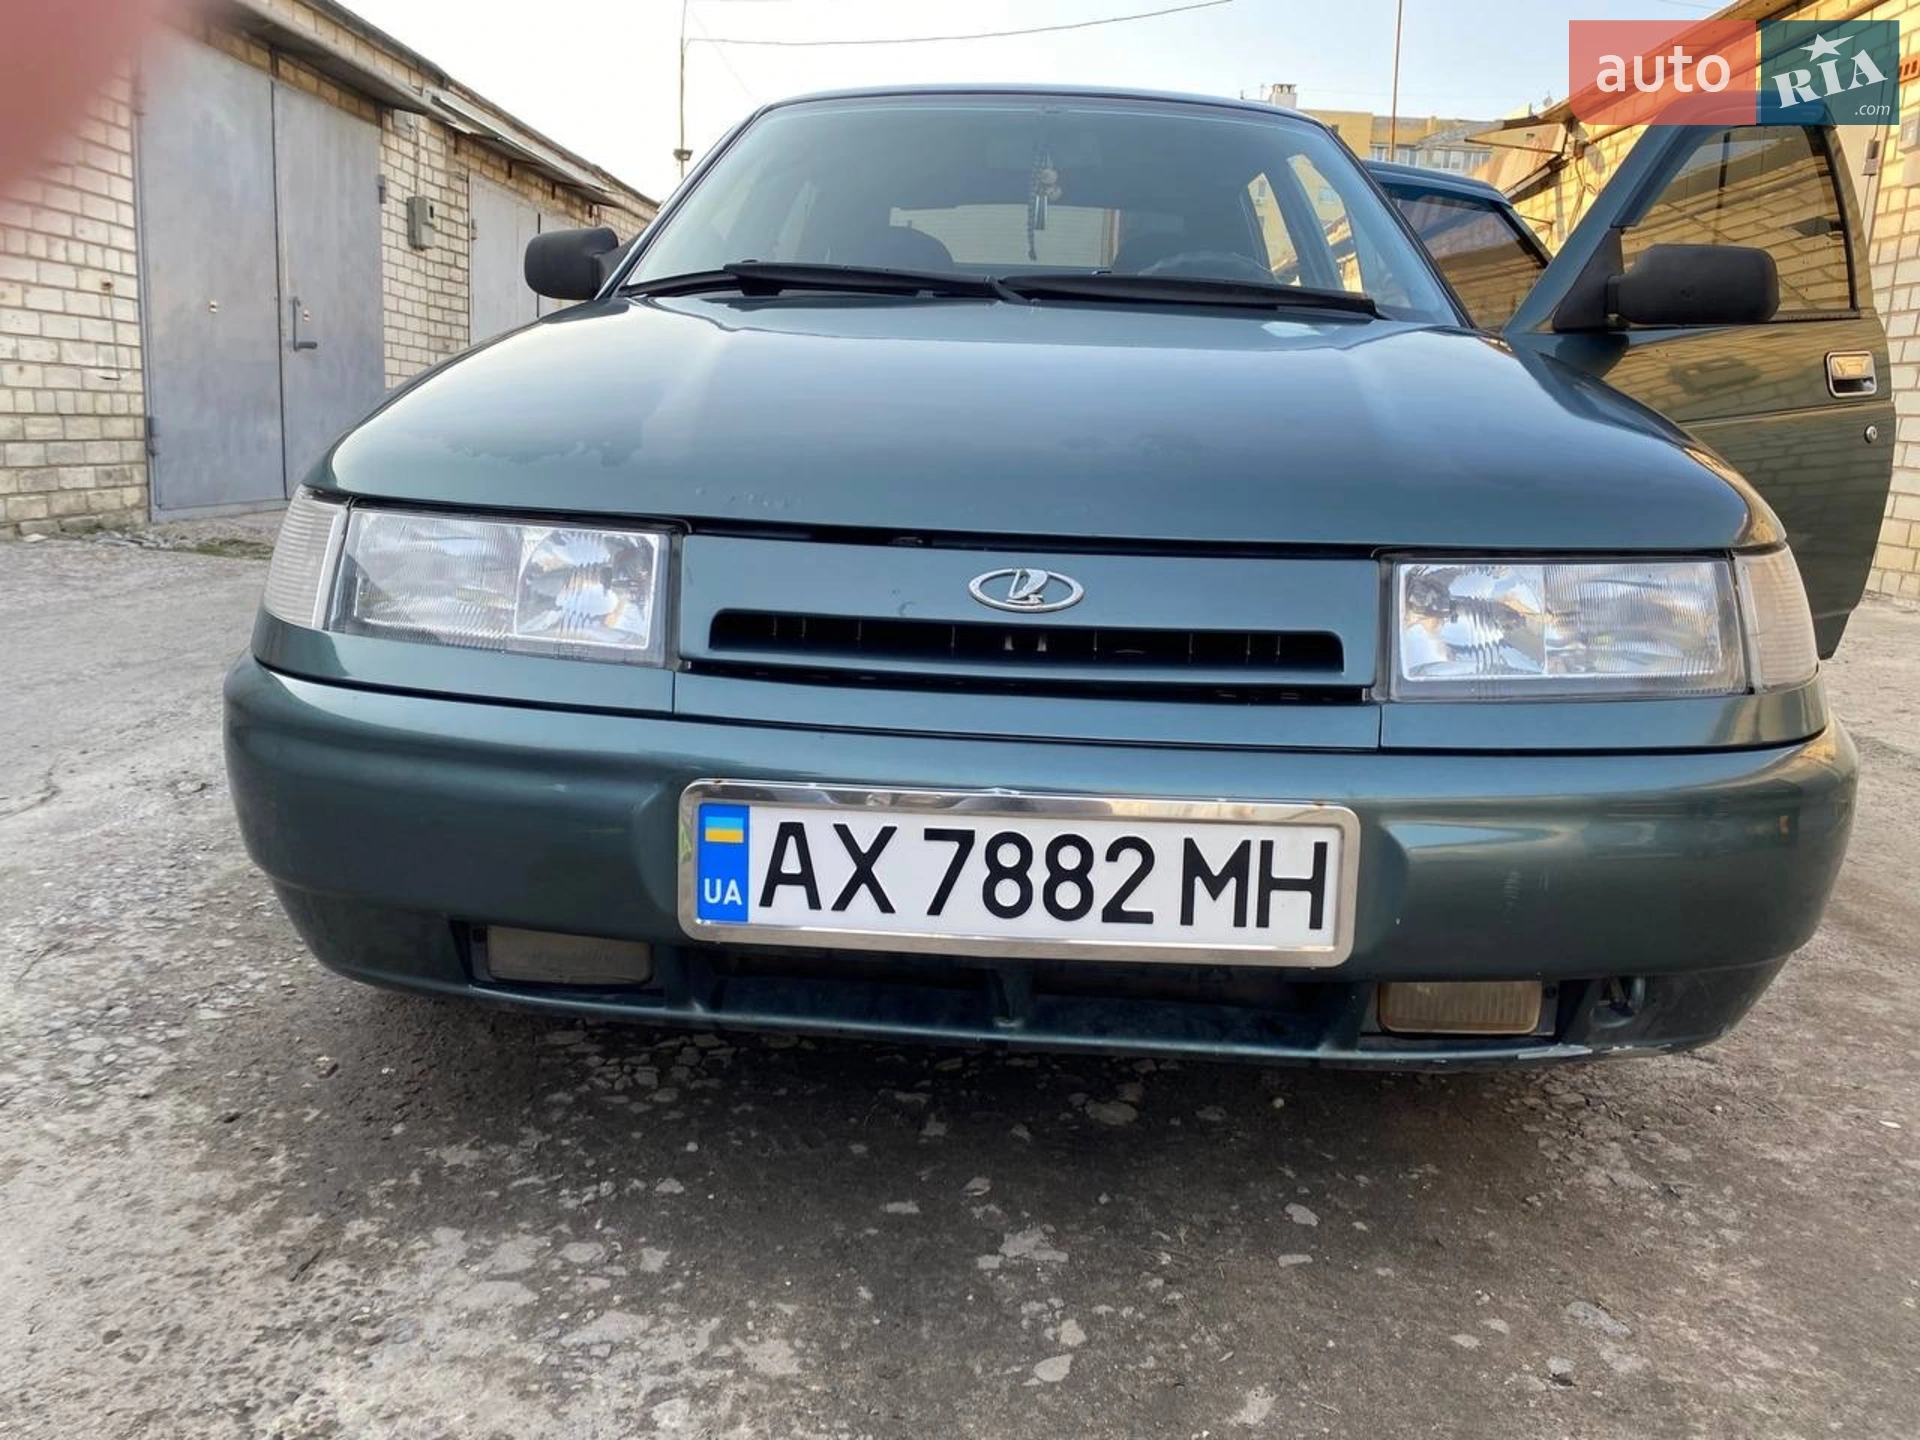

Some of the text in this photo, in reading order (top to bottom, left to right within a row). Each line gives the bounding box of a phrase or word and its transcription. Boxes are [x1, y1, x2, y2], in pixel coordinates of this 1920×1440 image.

[704, 879, 743, 907] UA
[759, 821, 1329, 930] AX 7882 MH
